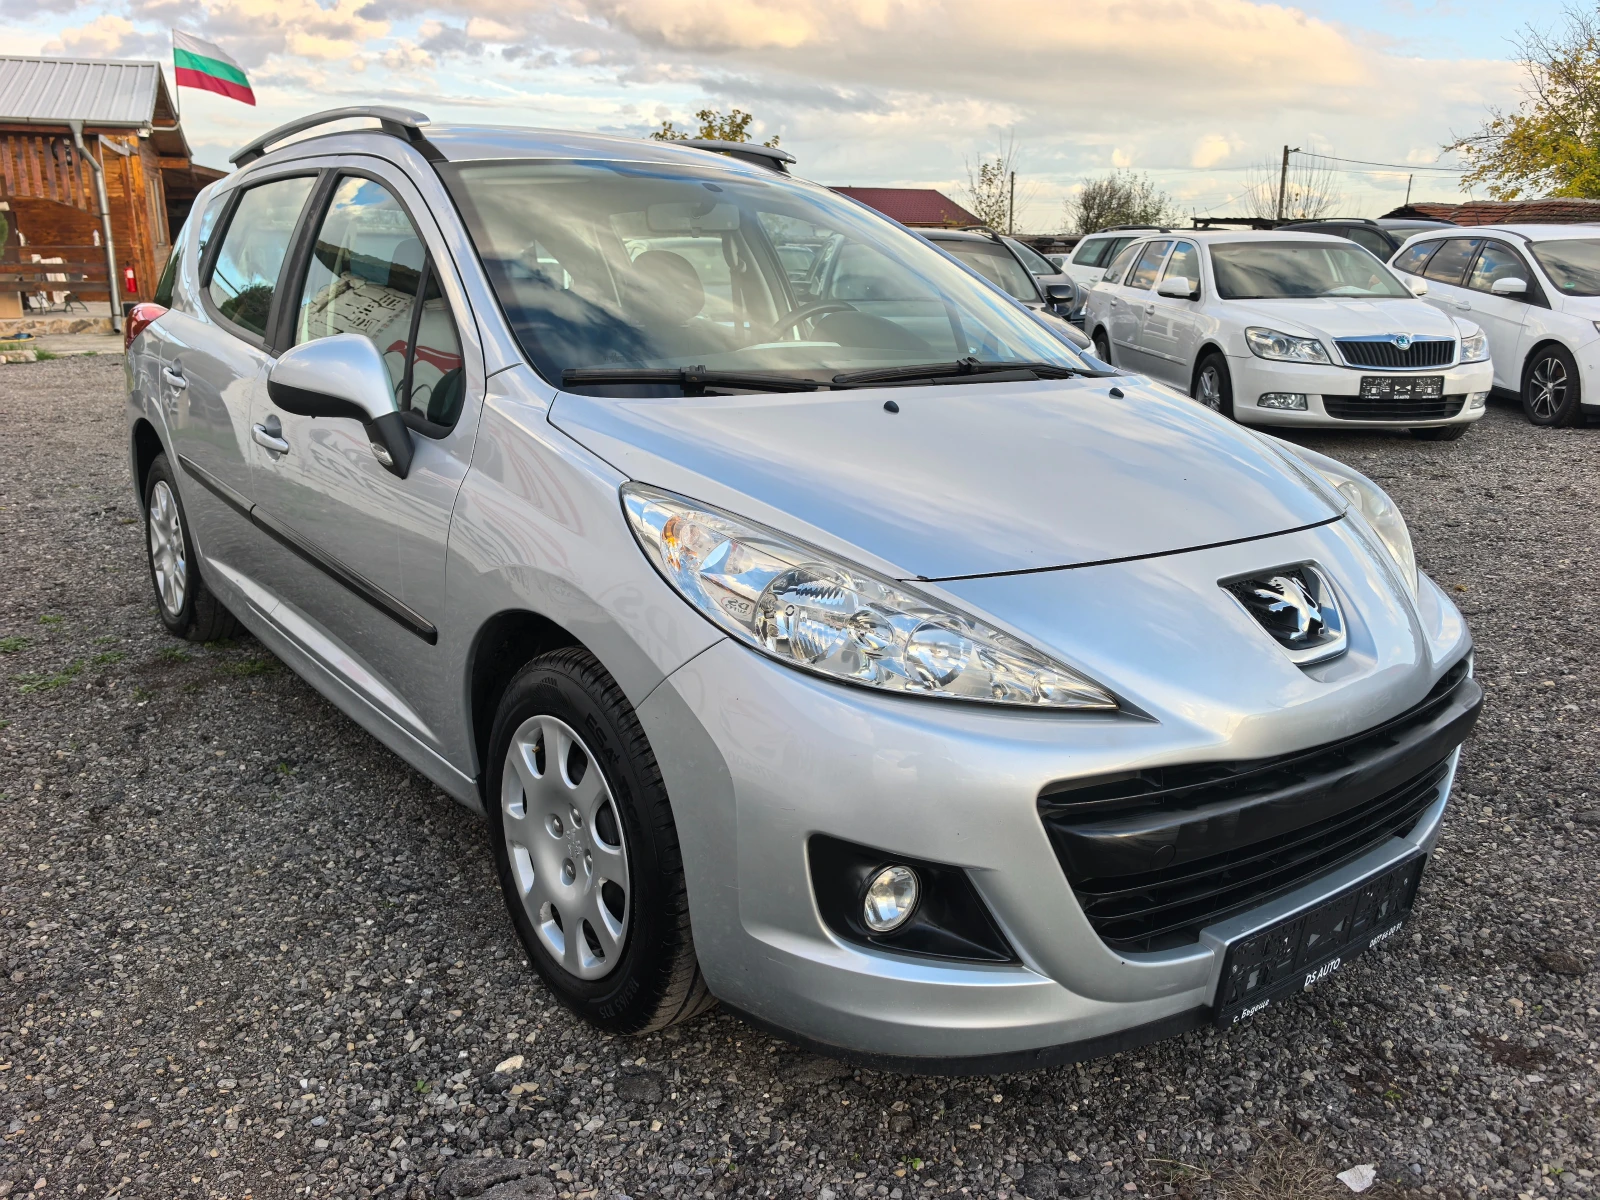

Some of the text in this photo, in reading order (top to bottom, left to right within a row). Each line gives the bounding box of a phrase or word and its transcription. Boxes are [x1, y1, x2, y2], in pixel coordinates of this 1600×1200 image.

[1304, 957, 1341, 987] DS AUTO
[614, 976, 640, 1013] 185/65
[598, 1003, 616, 1019] R15
